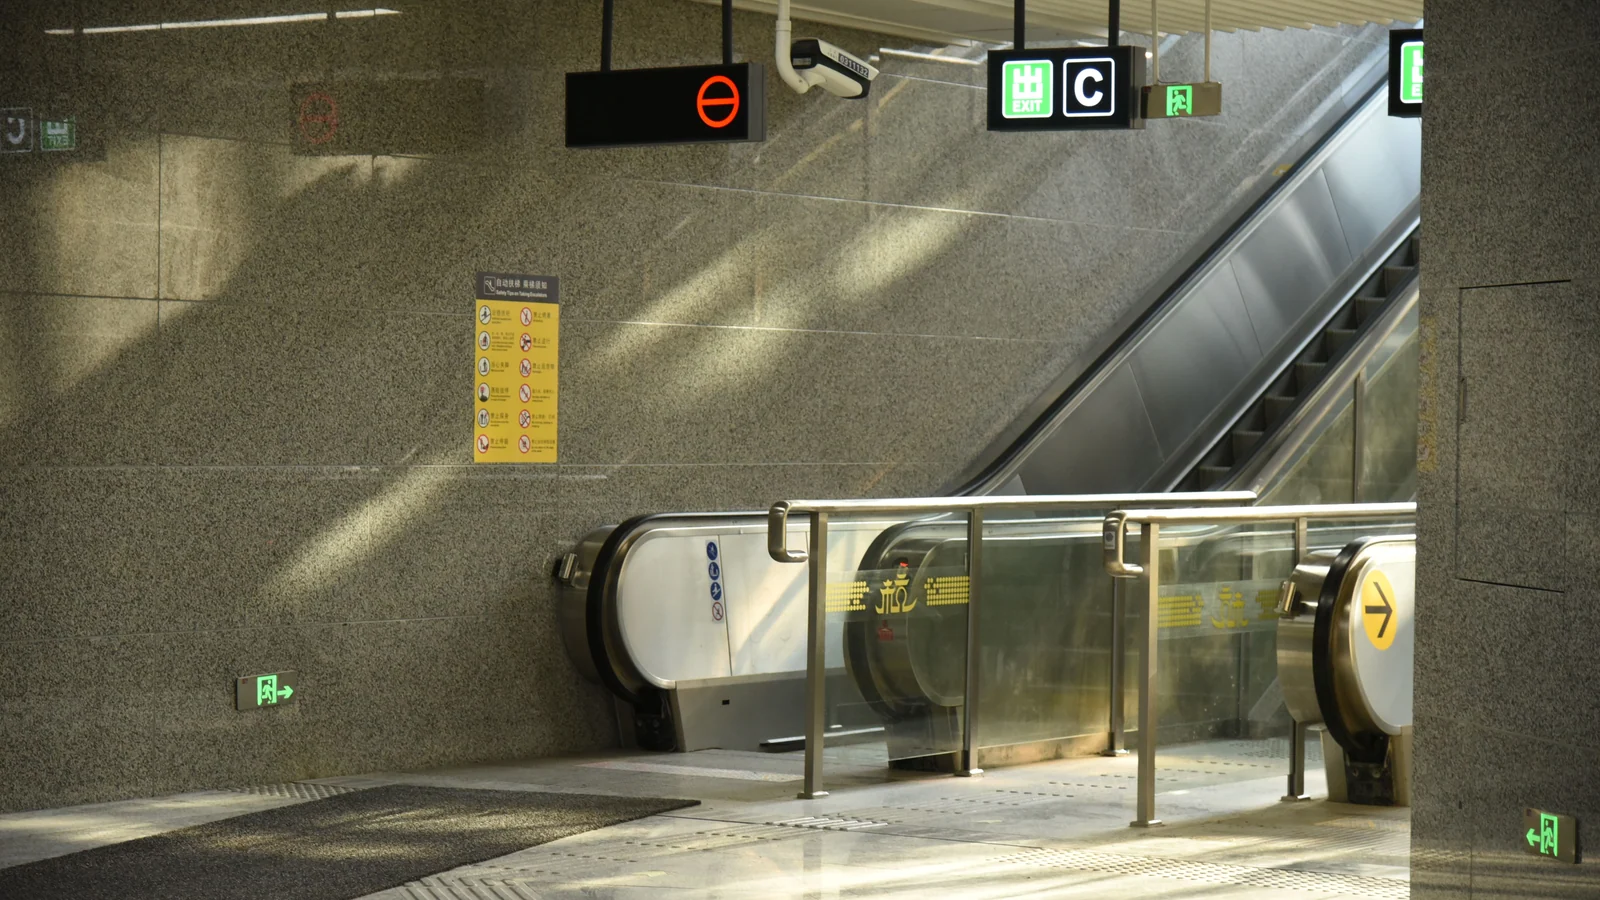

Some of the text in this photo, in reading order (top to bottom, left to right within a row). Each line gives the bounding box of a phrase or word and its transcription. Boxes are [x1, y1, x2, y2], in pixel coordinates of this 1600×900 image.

[1074, 68, 1104, 107] C
[1012, 100, 1043, 113] EXIT
[496, 278, 520, 288] 自动扶梯
